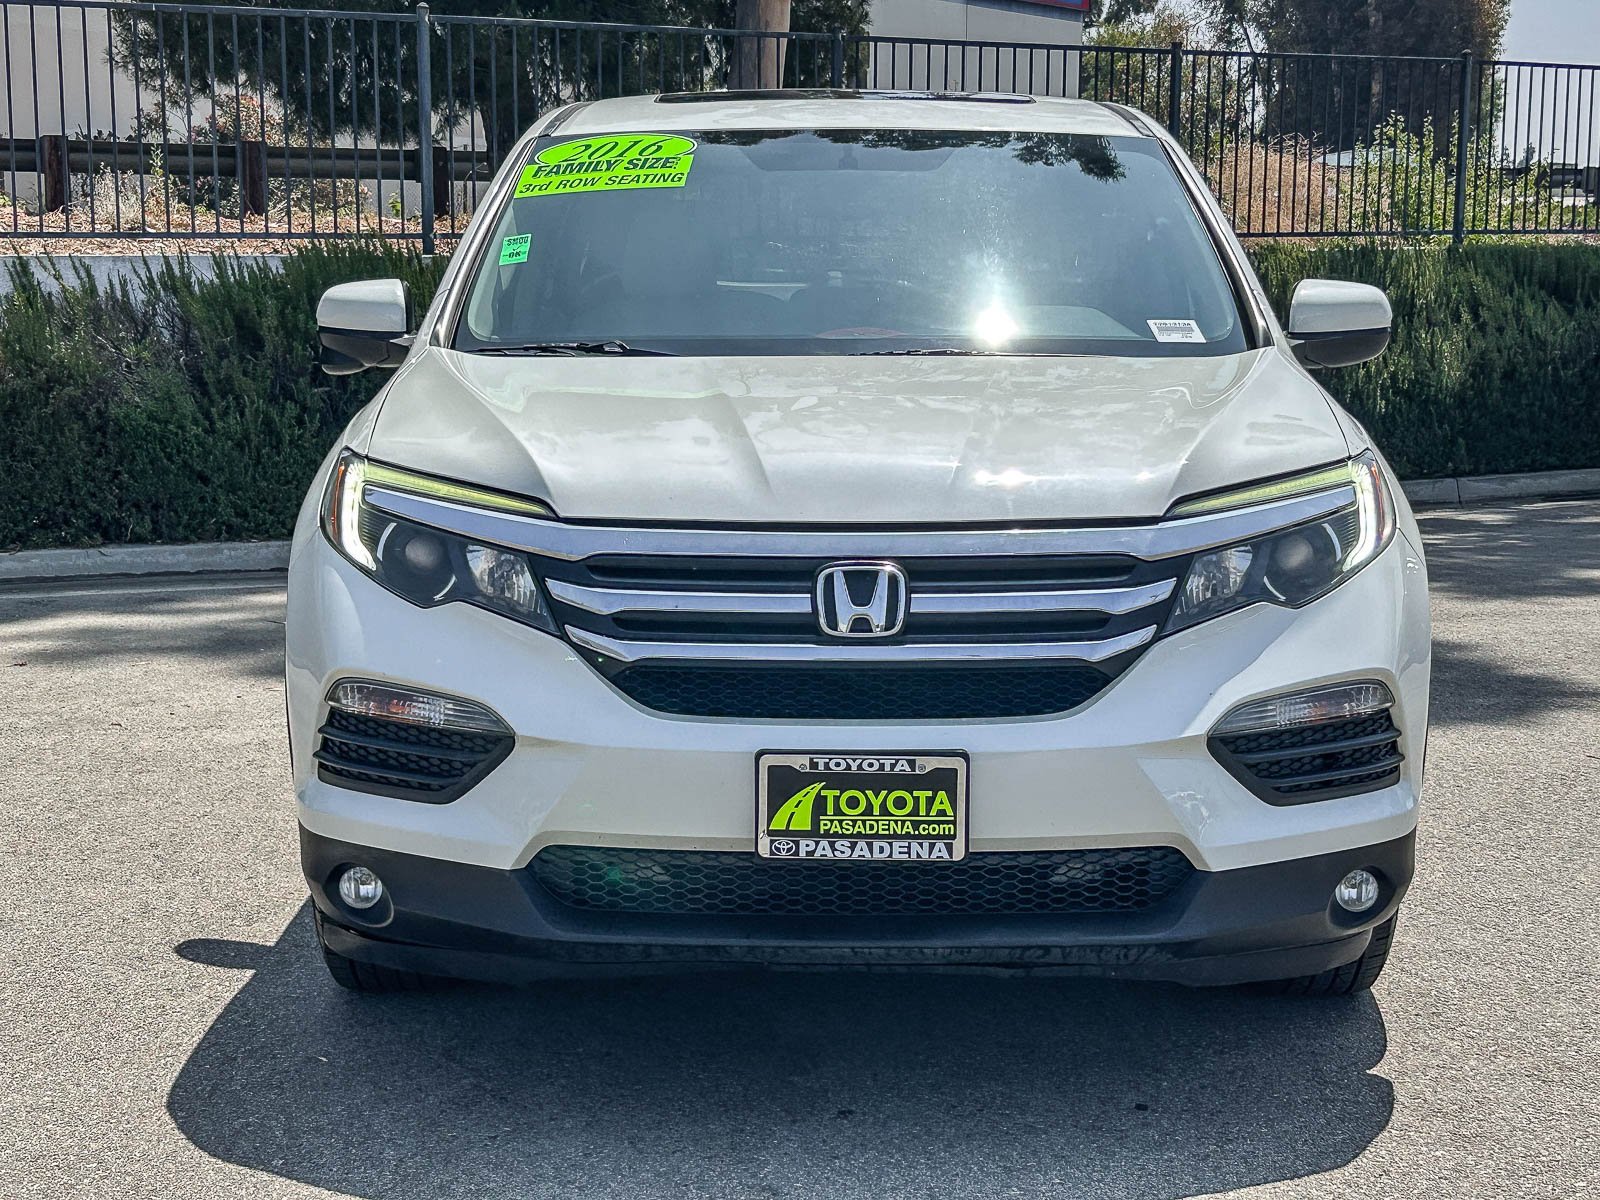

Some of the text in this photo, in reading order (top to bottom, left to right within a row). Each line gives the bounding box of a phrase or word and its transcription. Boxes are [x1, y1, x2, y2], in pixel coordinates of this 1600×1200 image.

[558, 138, 673, 162] 2016
[531, 158, 624, 179] FAMILY
[519, 172, 685, 193] 3rd ROW SEATING
[813, 758, 912, 772] TOYOTA
[820, 789, 955, 816] TOYOTA
[819, 820, 955, 835] PASADENA.com
[799, 840, 950, 859] PASADENA
